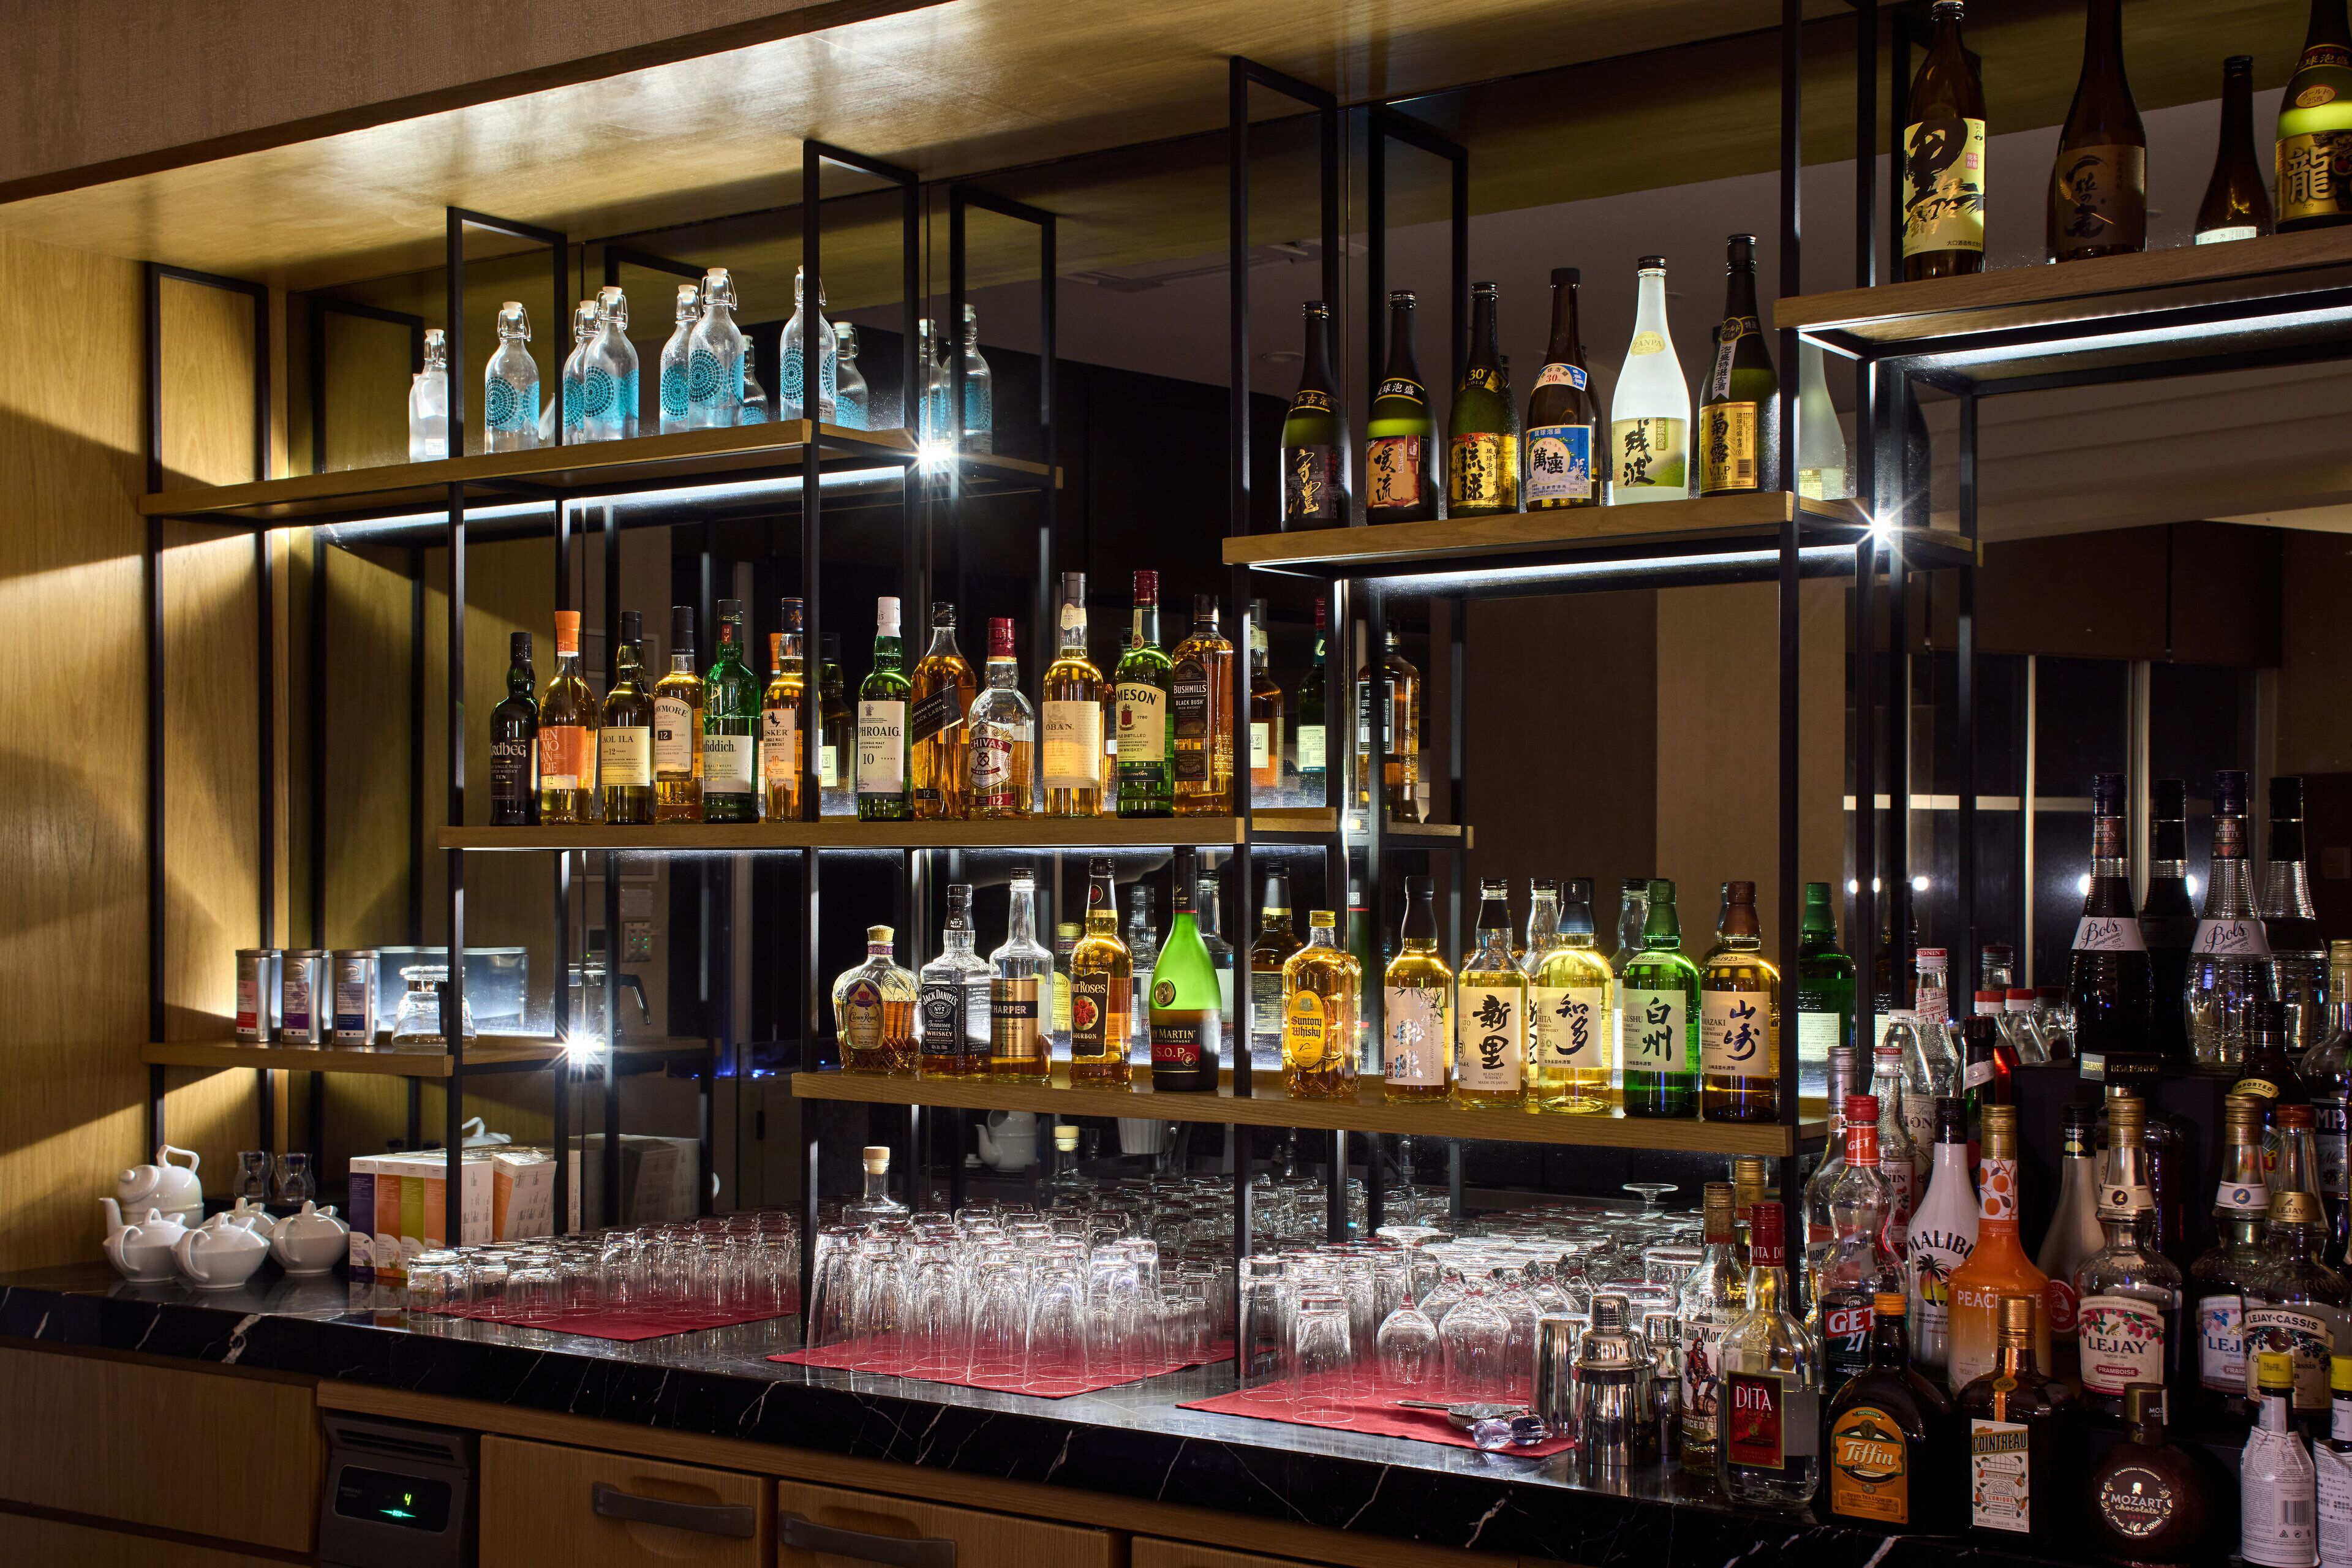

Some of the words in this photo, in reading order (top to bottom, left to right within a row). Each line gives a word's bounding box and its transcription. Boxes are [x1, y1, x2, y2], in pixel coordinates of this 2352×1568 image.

[2286, 146, 2337, 204] 龍
[1633, 339, 1662, 349] ZANPA
[1715, 345, 1732, 391] 泡盛特選古酒
[1546, 374, 1558, 383] 30
[1485, 448, 1494, 478] 琉球泡盛
[1709, 466, 1730, 477] V.I.P
[1174, 684, 1207, 694] BUSHMILLS
[912, 707, 927, 719] JOHNNIE
[970, 739, 1004, 750] CHIVAS
[772, 755, 779, 767] 10
[863, 753, 875, 765] 10
[543, 762, 557, 773] GIE
[547, 776, 554, 785] 12
[922, 790, 930, 798] 12
[992, 796, 1003, 805] 12
[2080, 918, 2120, 950] Bols
[2203, 920, 2247, 952] Bols
[1079, 981, 1106, 993] Roses
[922, 992, 936, 1006] JACK
[935, 989, 959, 1006] DANIEL'S
[849, 1011, 864, 1023] Crown
[1291, 1016, 1322, 1027] Suntory
[928, 1020, 951, 1028] Tennessee
[1556, 993, 1589, 1055] 知多
[1642, 997, 1673, 1061] 白州
[1724, 999, 1760, 1061] 山崎
[1159, 1028, 1194, 1039] MARTIN
[1292, 1026, 1321, 1039] Whisky
[2110, 1063, 2159, 1074] DISARONNO
[2233, 1082, 2273, 1093] IMPORTED
[1847, 1137, 1871, 1151] GET
[2276, 1206, 2305, 1215] LEJAY
[1751, 1246, 1770, 1259] DITA
[1845, 1330, 1868, 1352] 27
[2087, 1336, 2148, 1355] LEJAY
[2098, 1366, 2136, 1376] FRAMBOISE
[1736, 1385, 1772, 1411] DITA
[1973, 1432, 2028, 1453] COINTREAU
[1844, 1441, 1894, 1466] Tiffin
[404, 1493, 412, 1506] 4
[2110, 1493, 2163, 1509] MOZART
[2114, 1503, 2160, 1515] chocolate
